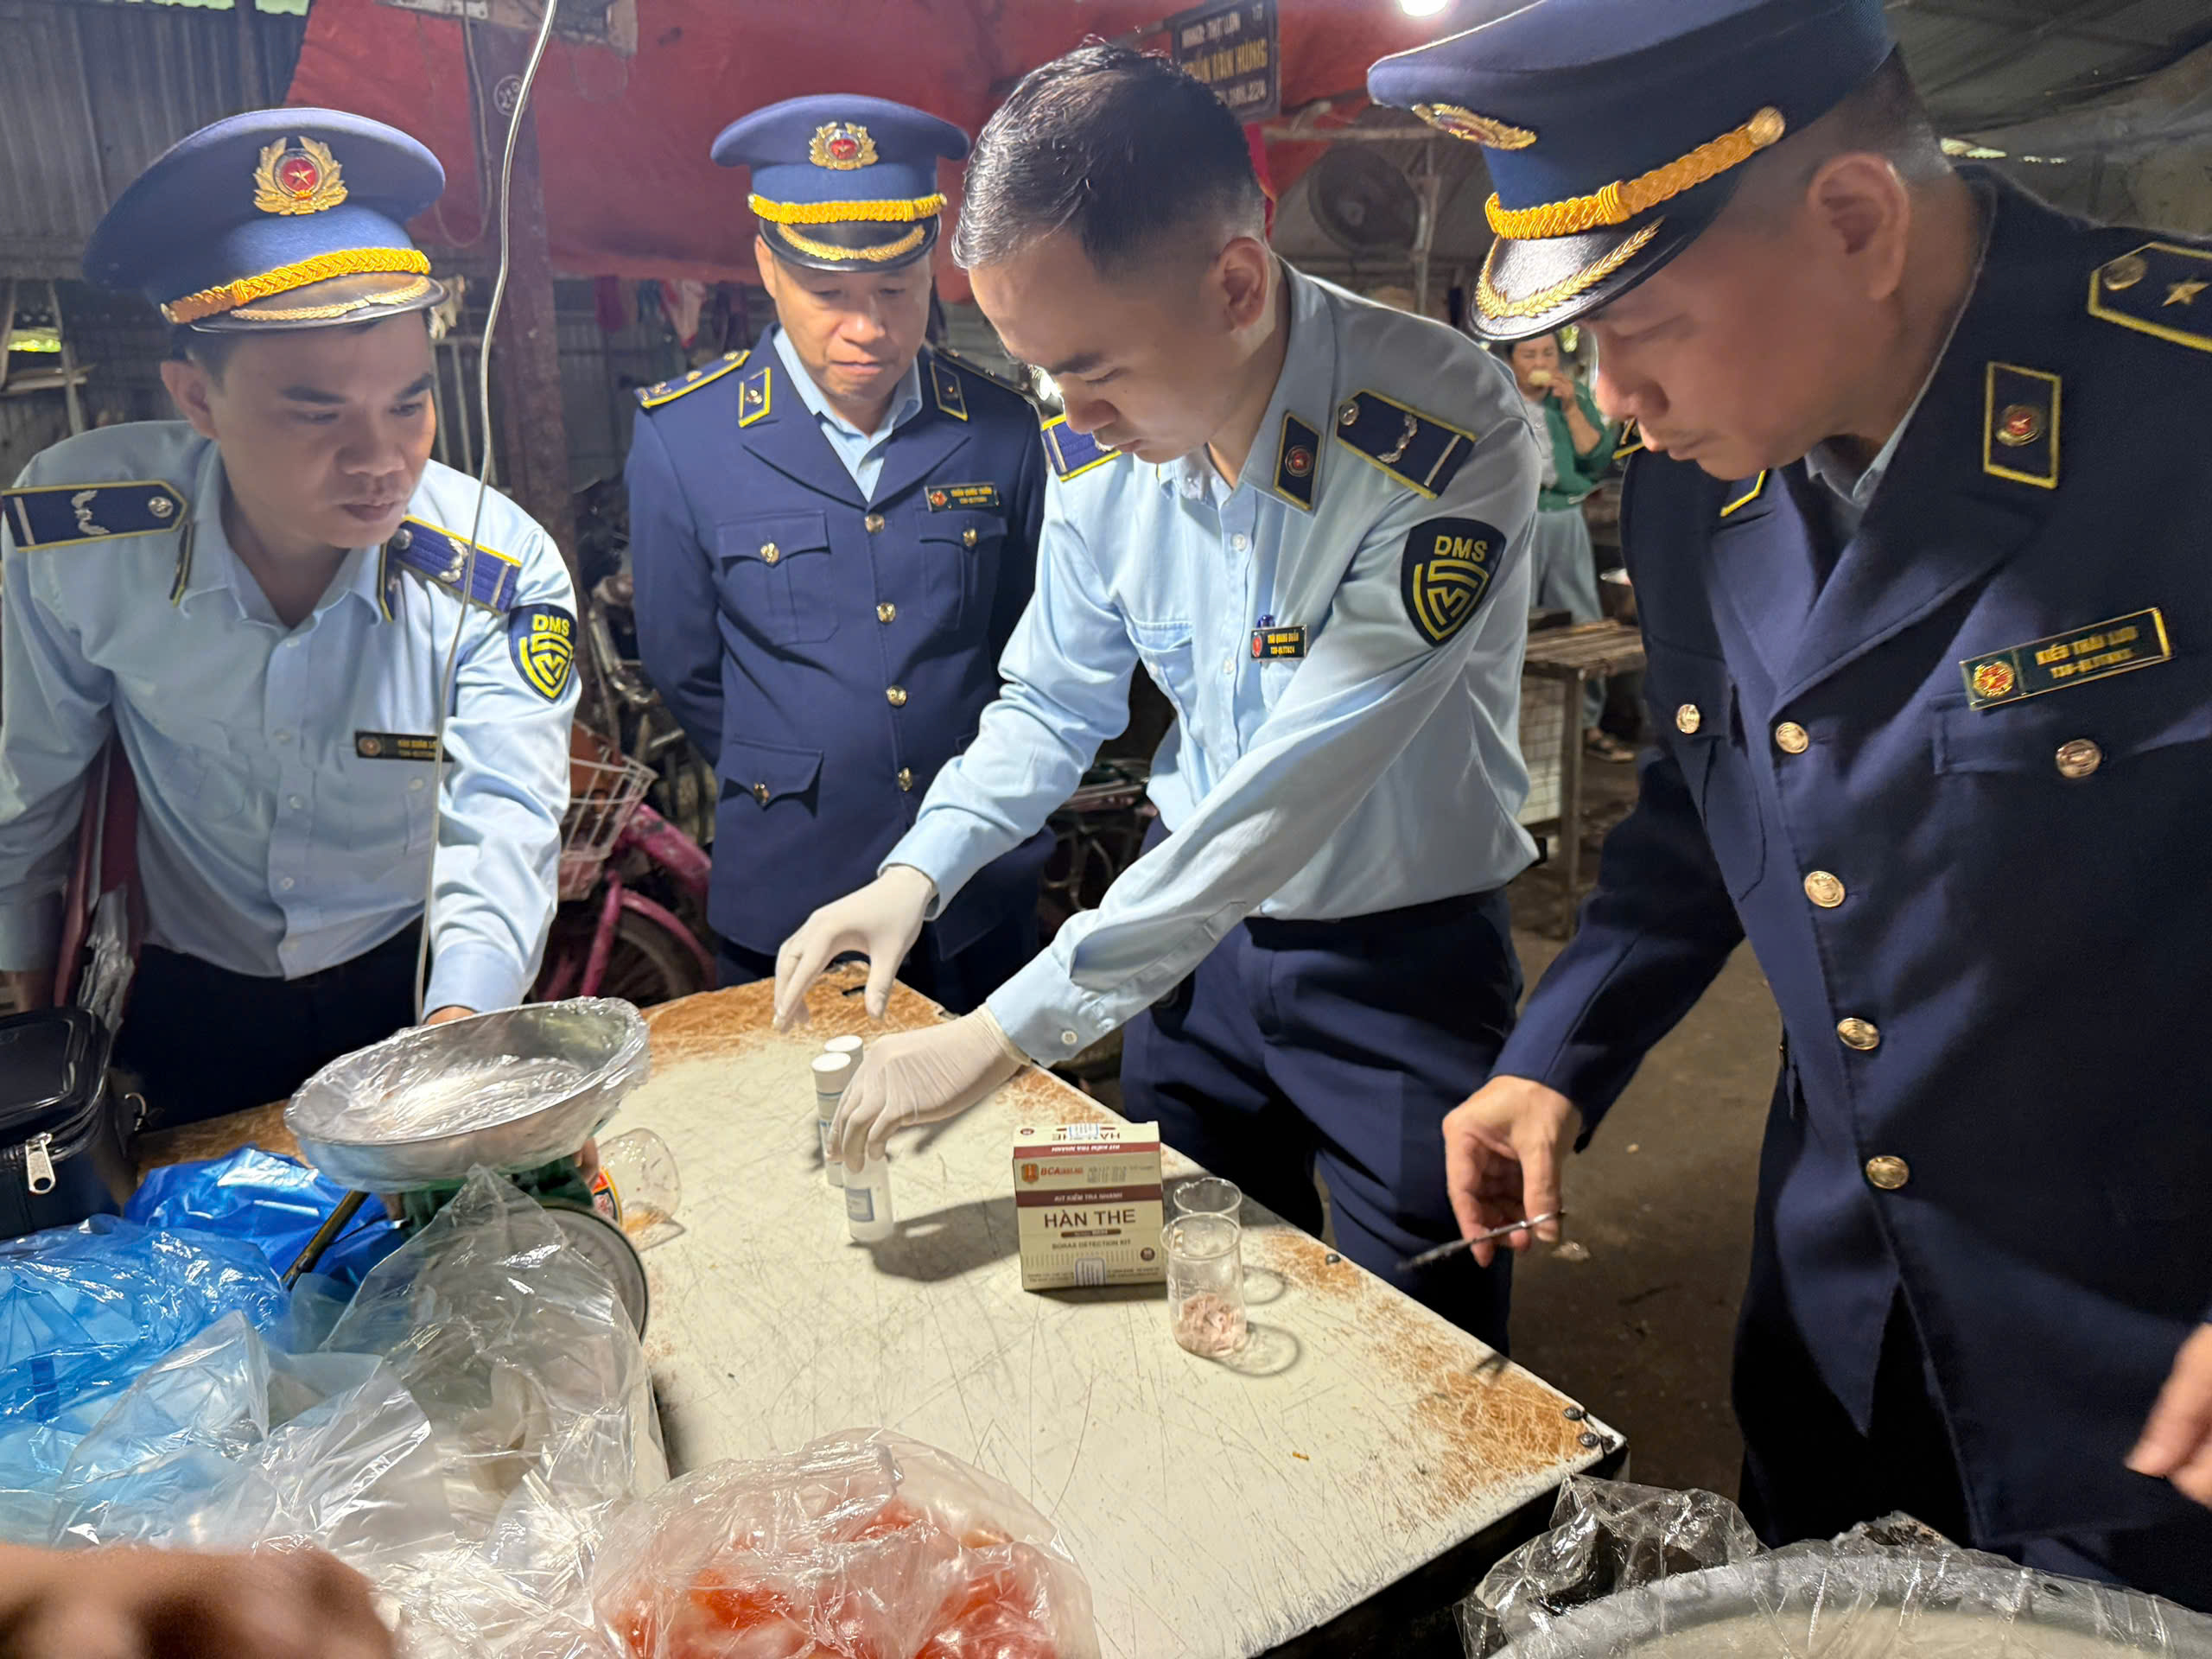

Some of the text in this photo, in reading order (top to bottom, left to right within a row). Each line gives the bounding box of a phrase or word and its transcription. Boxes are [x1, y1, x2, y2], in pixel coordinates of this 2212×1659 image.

[1433, 535, 1488, 562] DMS
[532, 613, 570, 637] DMS
[1044, 1209, 1136, 1227] HÀN THE
